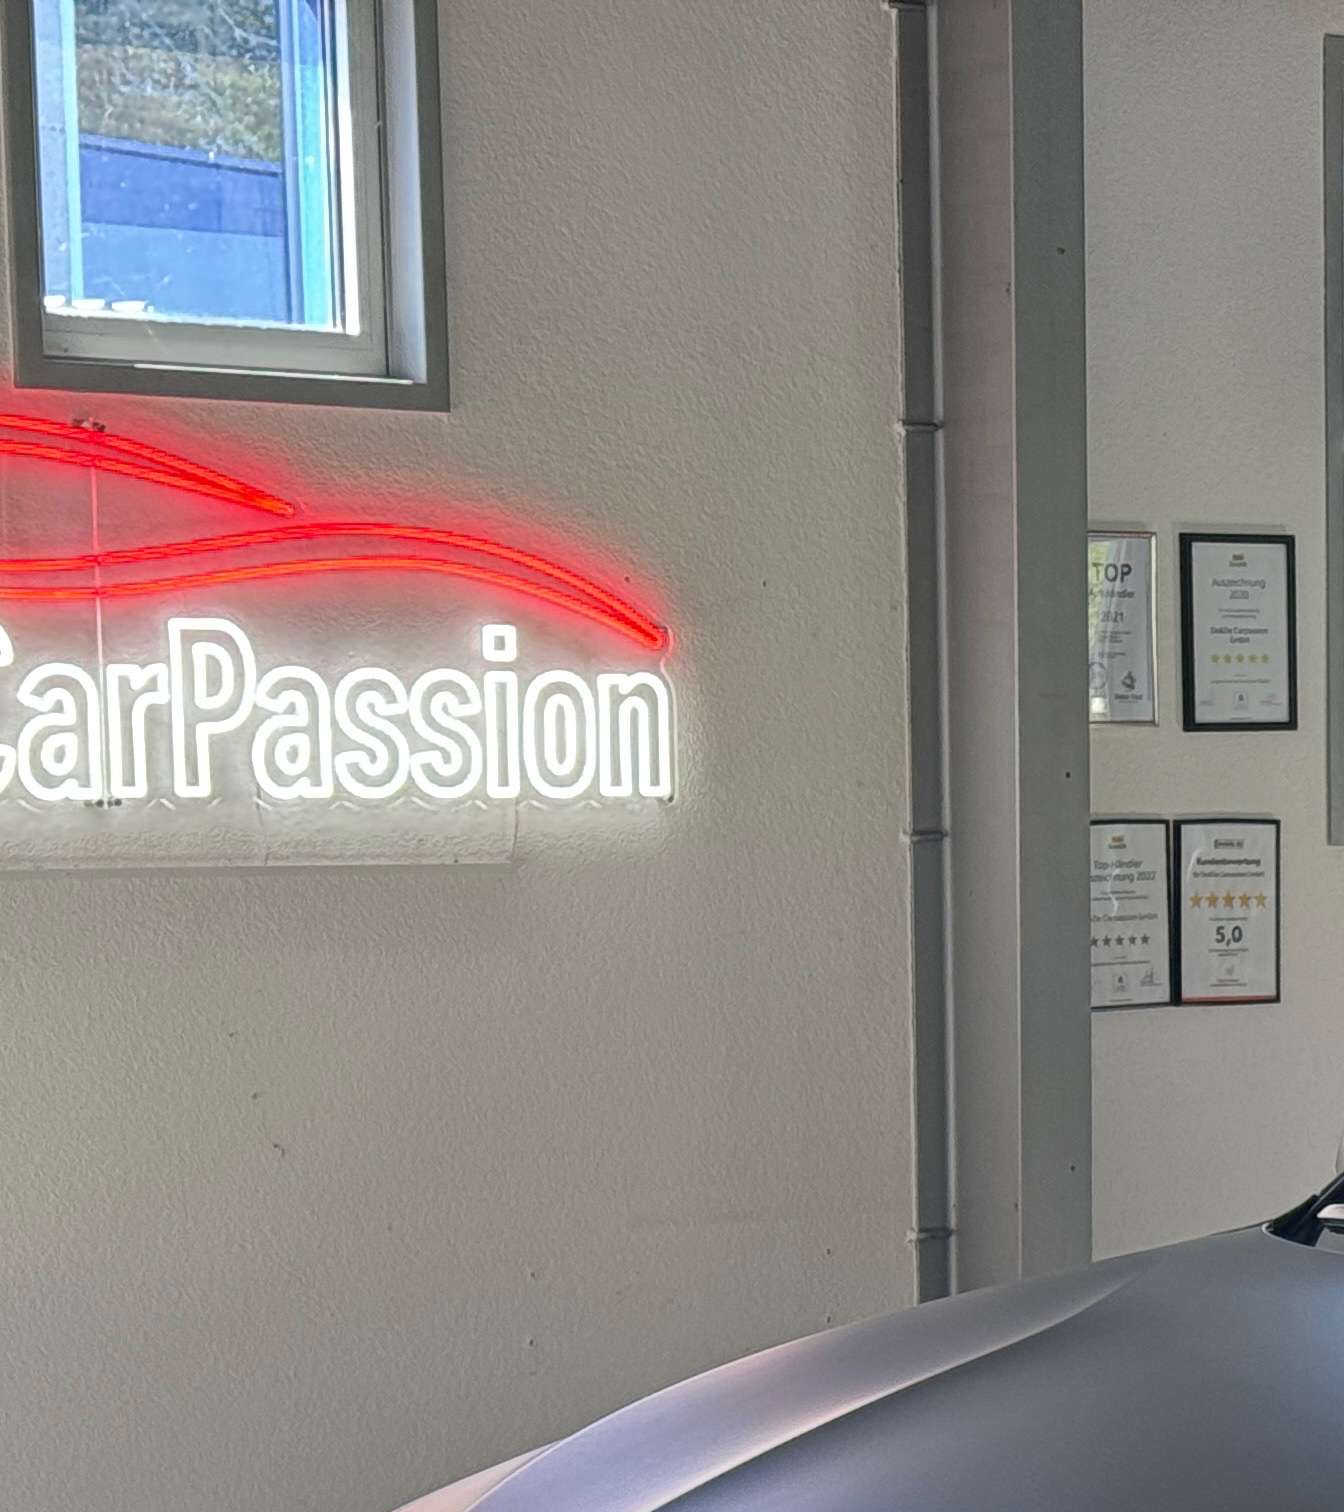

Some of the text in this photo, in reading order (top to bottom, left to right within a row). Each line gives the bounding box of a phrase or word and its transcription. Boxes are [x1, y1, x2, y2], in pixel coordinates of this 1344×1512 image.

[1092, 562, 1132, 583] TOP
[0, 617, 674, 800] arPassion
[1215, 925, 1243, 947] 5,0
